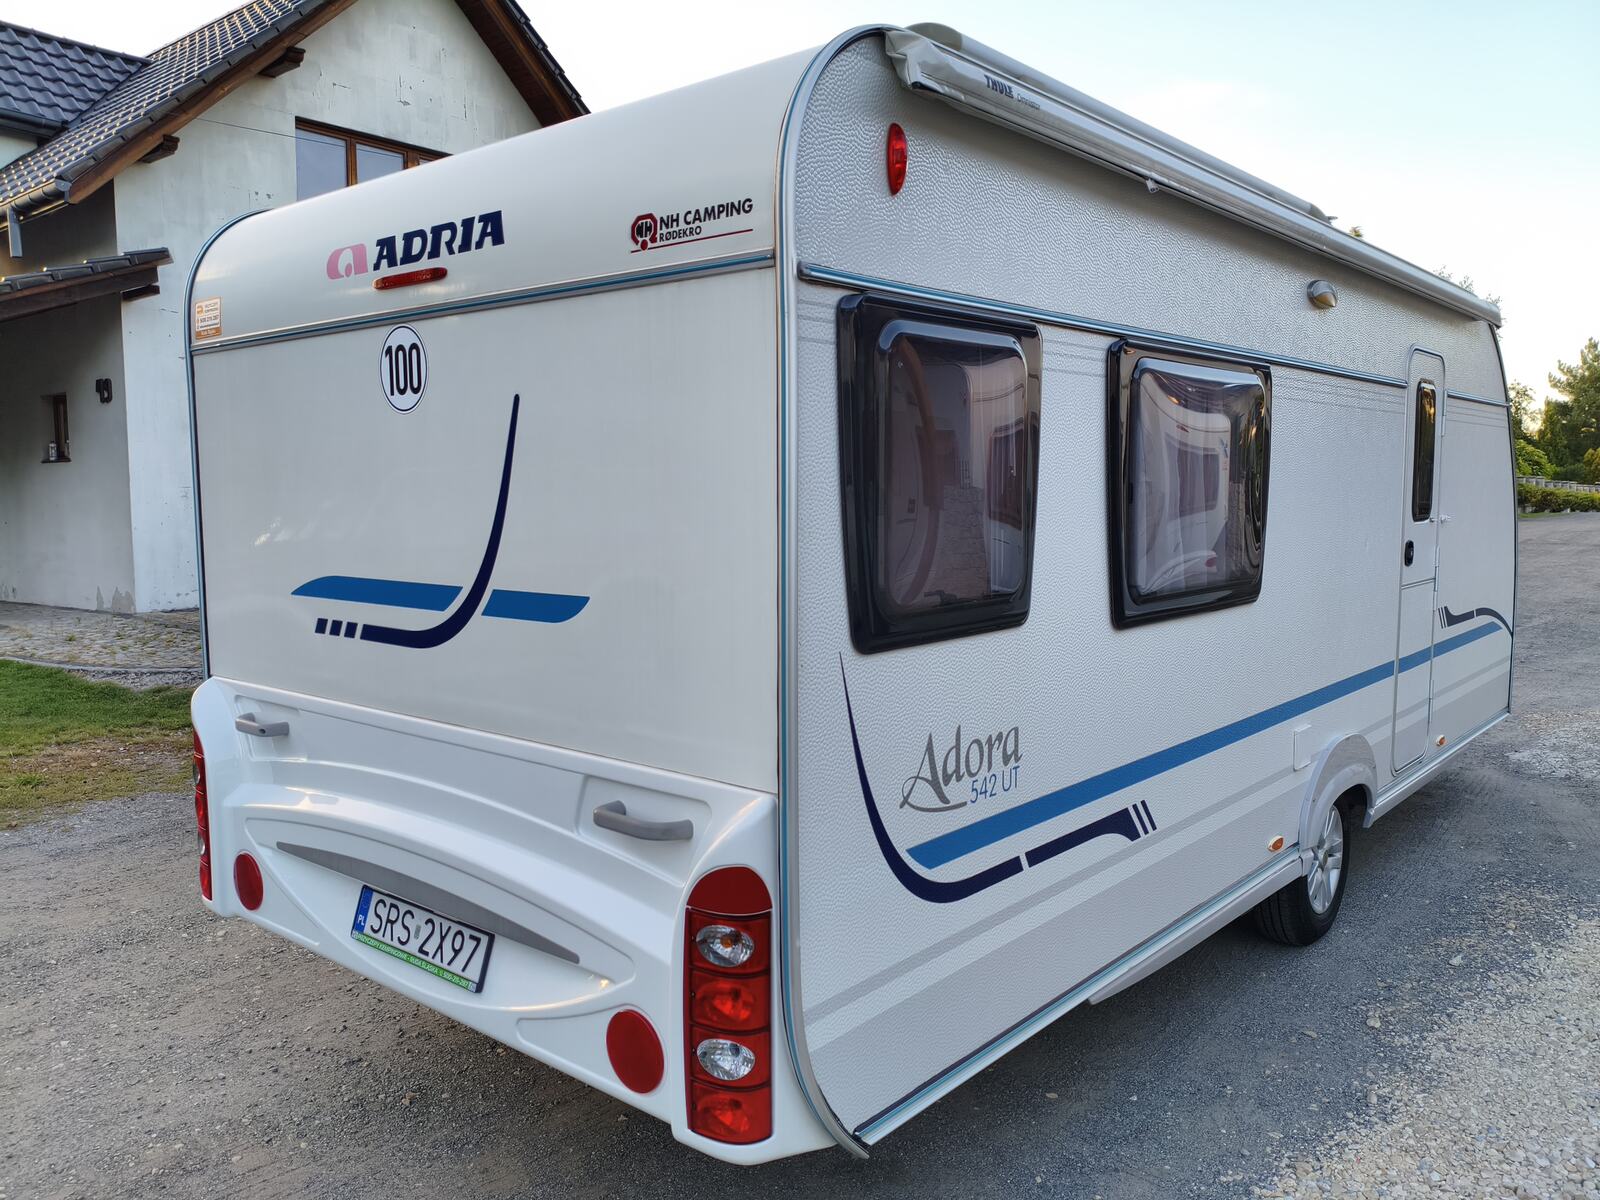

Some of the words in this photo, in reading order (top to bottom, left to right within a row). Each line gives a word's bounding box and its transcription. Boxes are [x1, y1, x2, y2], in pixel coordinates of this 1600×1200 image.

[984, 74, 1014, 99] THULE
[660, 213, 680, 230] NH
[684, 198, 753, 225] CAMPING
[373, 210, 505, 271] ADRIA
[659, 225, 702, 243] RØDEKRO
[385, 343, 422, 396] 100
[900, 724, 1023, 813] Adora
[970, 773, 997, 804] 542
[1002, 765, 1020, 792] UT
[358, 914, 365, 926] PL
[370, 898, 415, 946] SRS
[417, 917, 482, 973] 2X97
